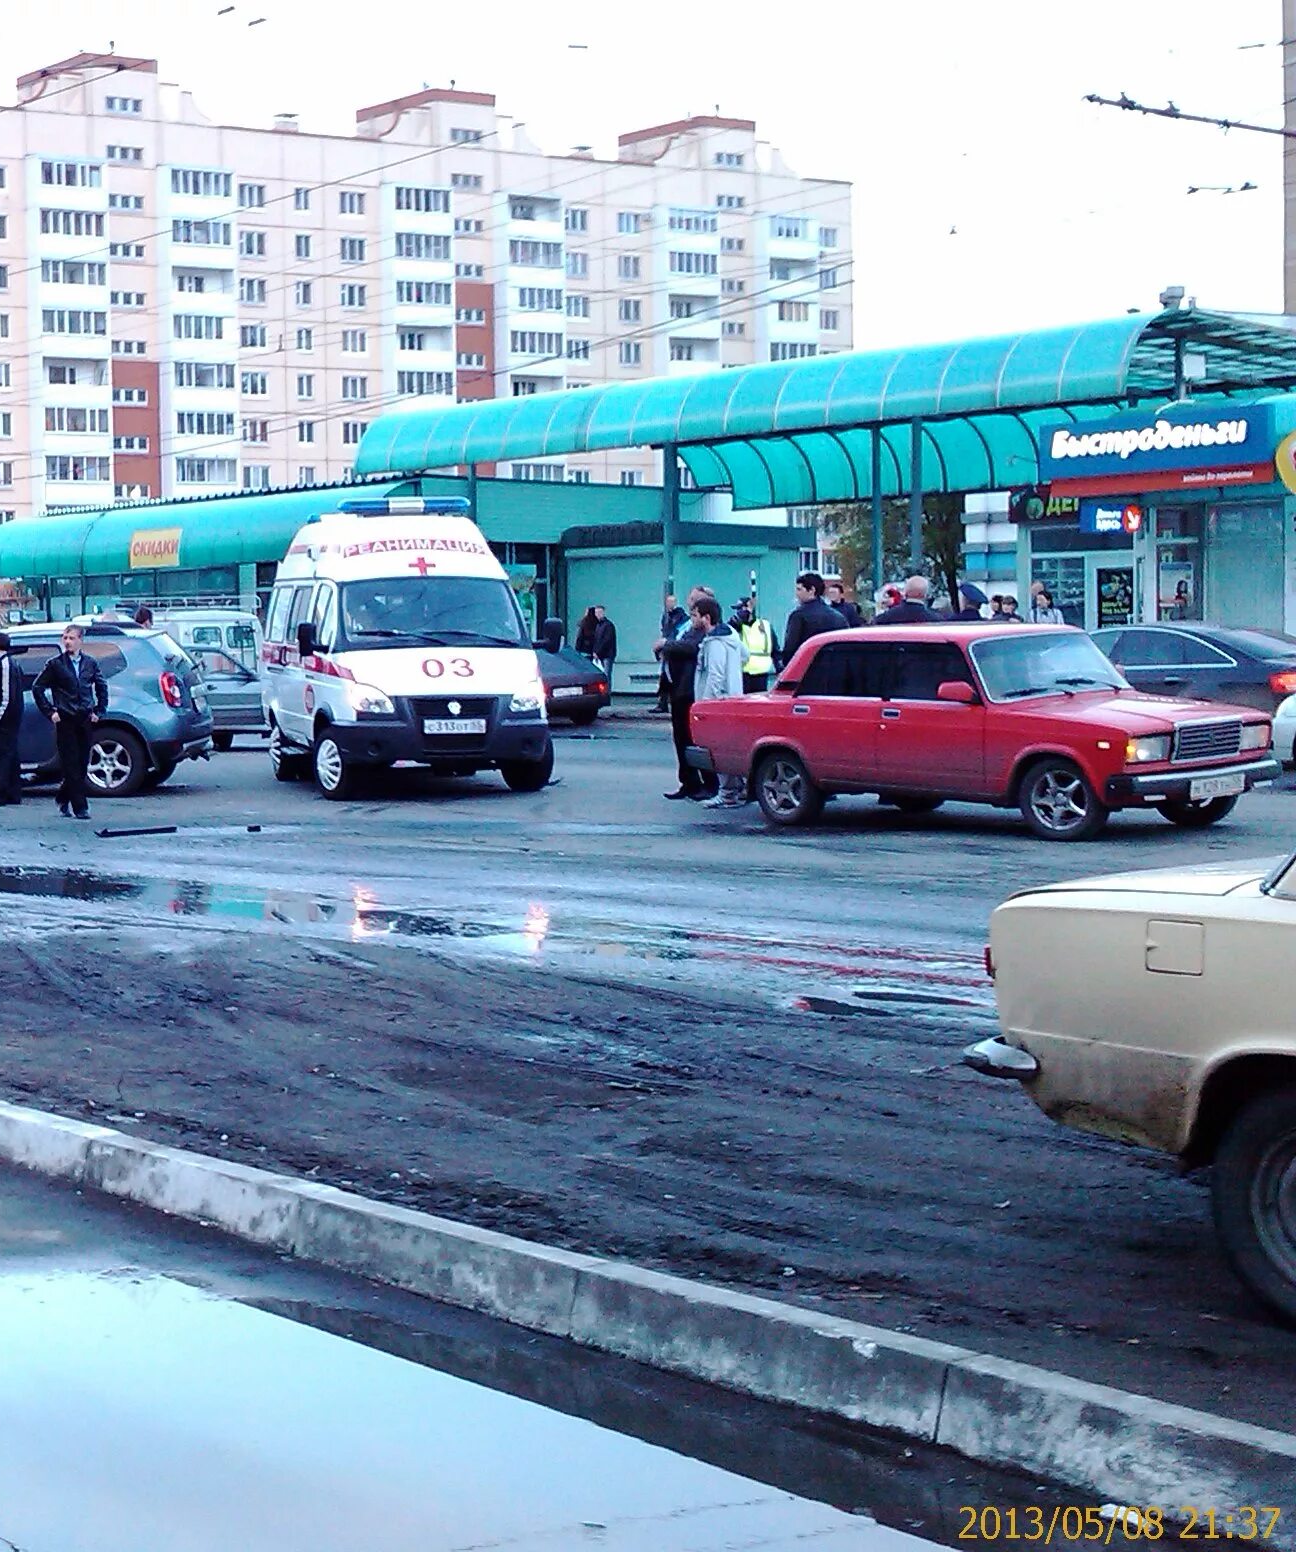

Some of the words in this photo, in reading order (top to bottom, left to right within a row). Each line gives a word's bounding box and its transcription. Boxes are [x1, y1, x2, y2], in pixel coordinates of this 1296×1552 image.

[1051, 420, 1248, 458] Быстроденьги
[132, 539, 180, 560] СКИДКИ
[343, 539, 486, 558] РЕАНИМАЦИЯ
[421, 658, 475, 678] 03
